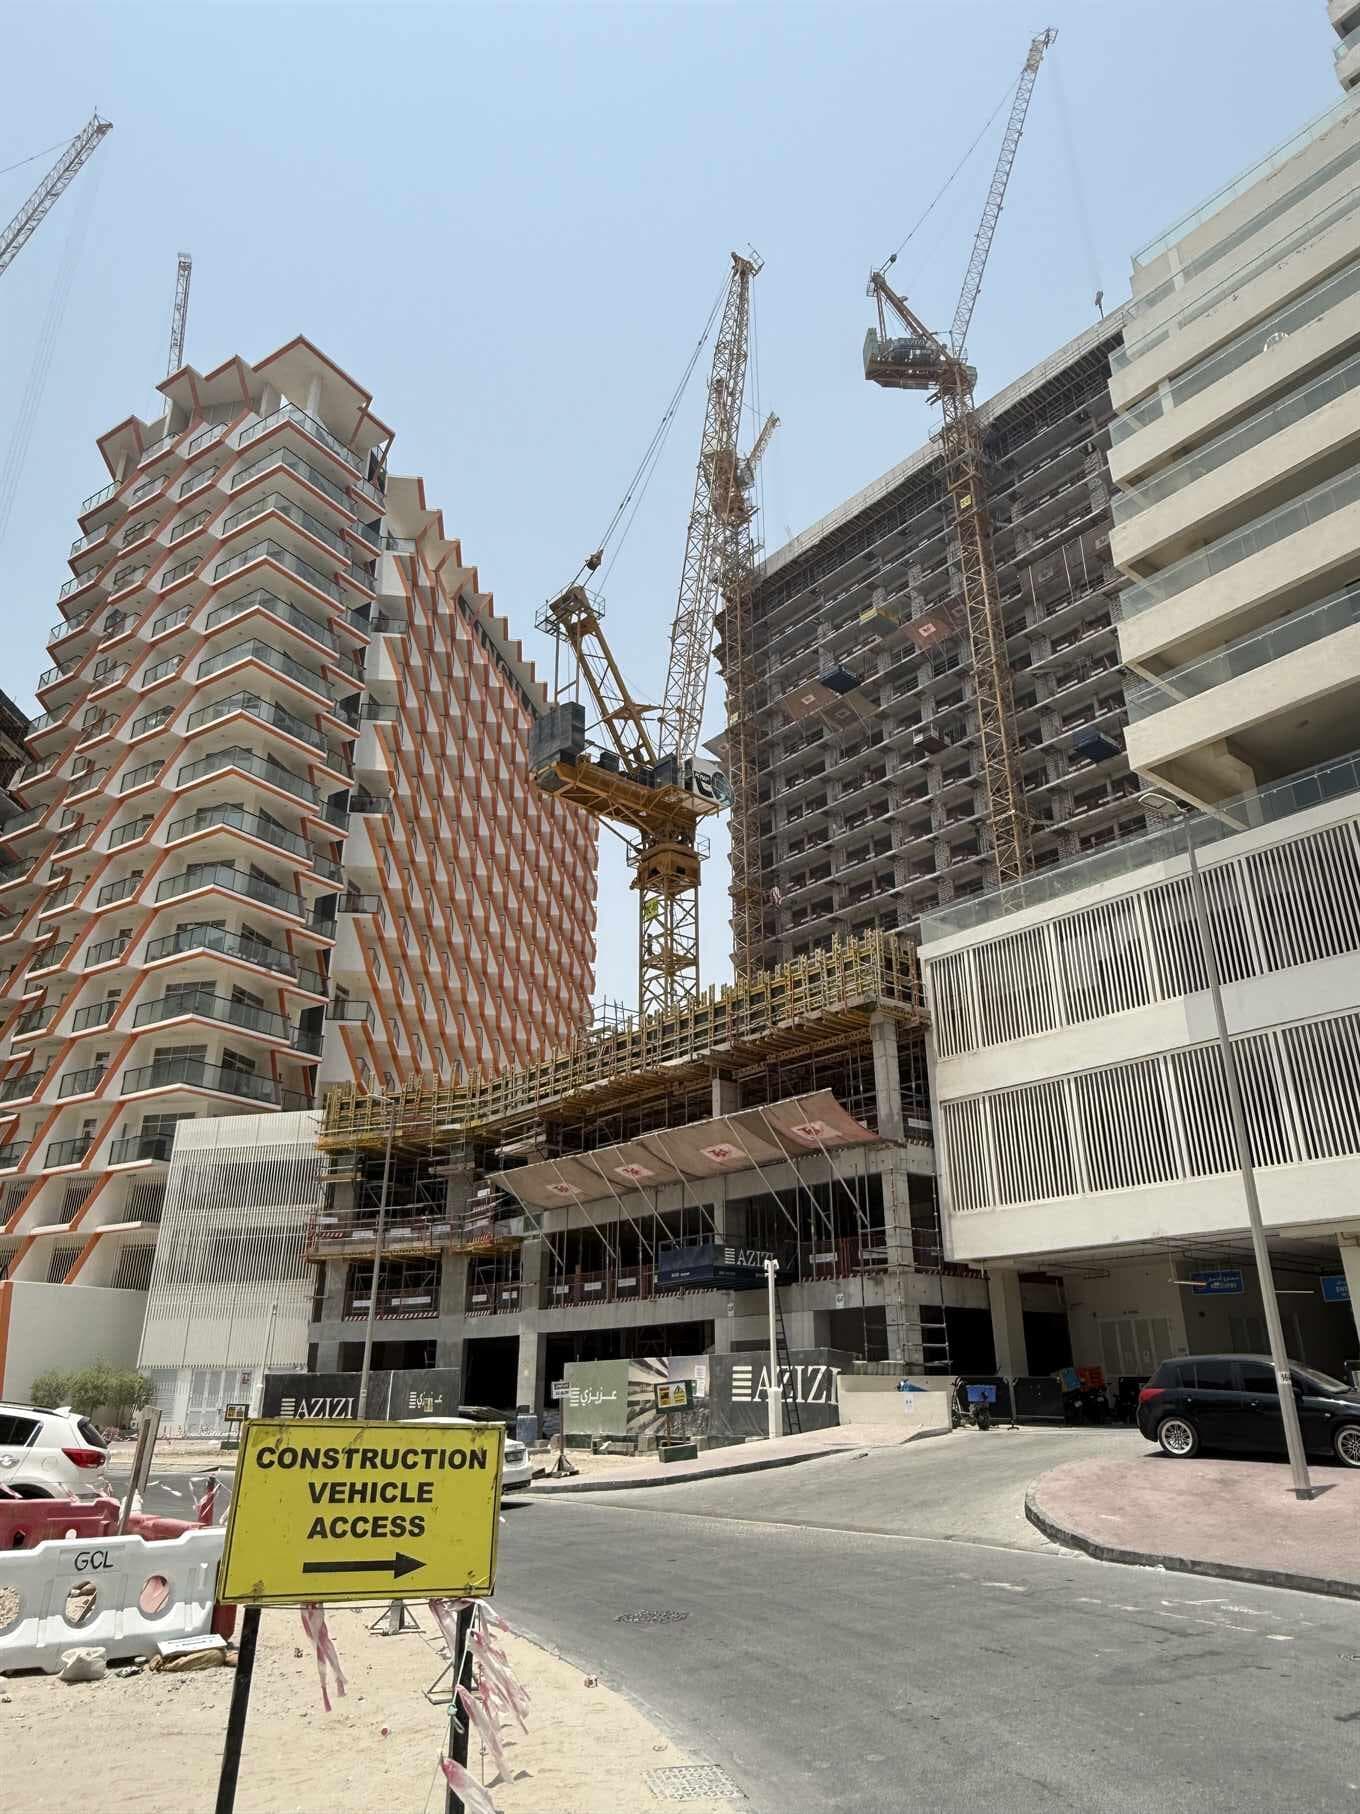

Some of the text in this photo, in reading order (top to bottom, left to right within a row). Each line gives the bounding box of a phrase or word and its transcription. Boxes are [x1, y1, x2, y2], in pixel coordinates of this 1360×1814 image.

[753, 1365, 842, 1405] AZIZI
[295, 1397, 355, 1419] AZIZI
[580, 1386, 617, 1408] عزيزي
[256, 1447, 487, 1470] CONSTRUCTION
[308, 1481, 434, 1504] VEHICLE
[307, 1515, 425, 1539] ACCESS
[74, 1550, 114, 1571] GCL
